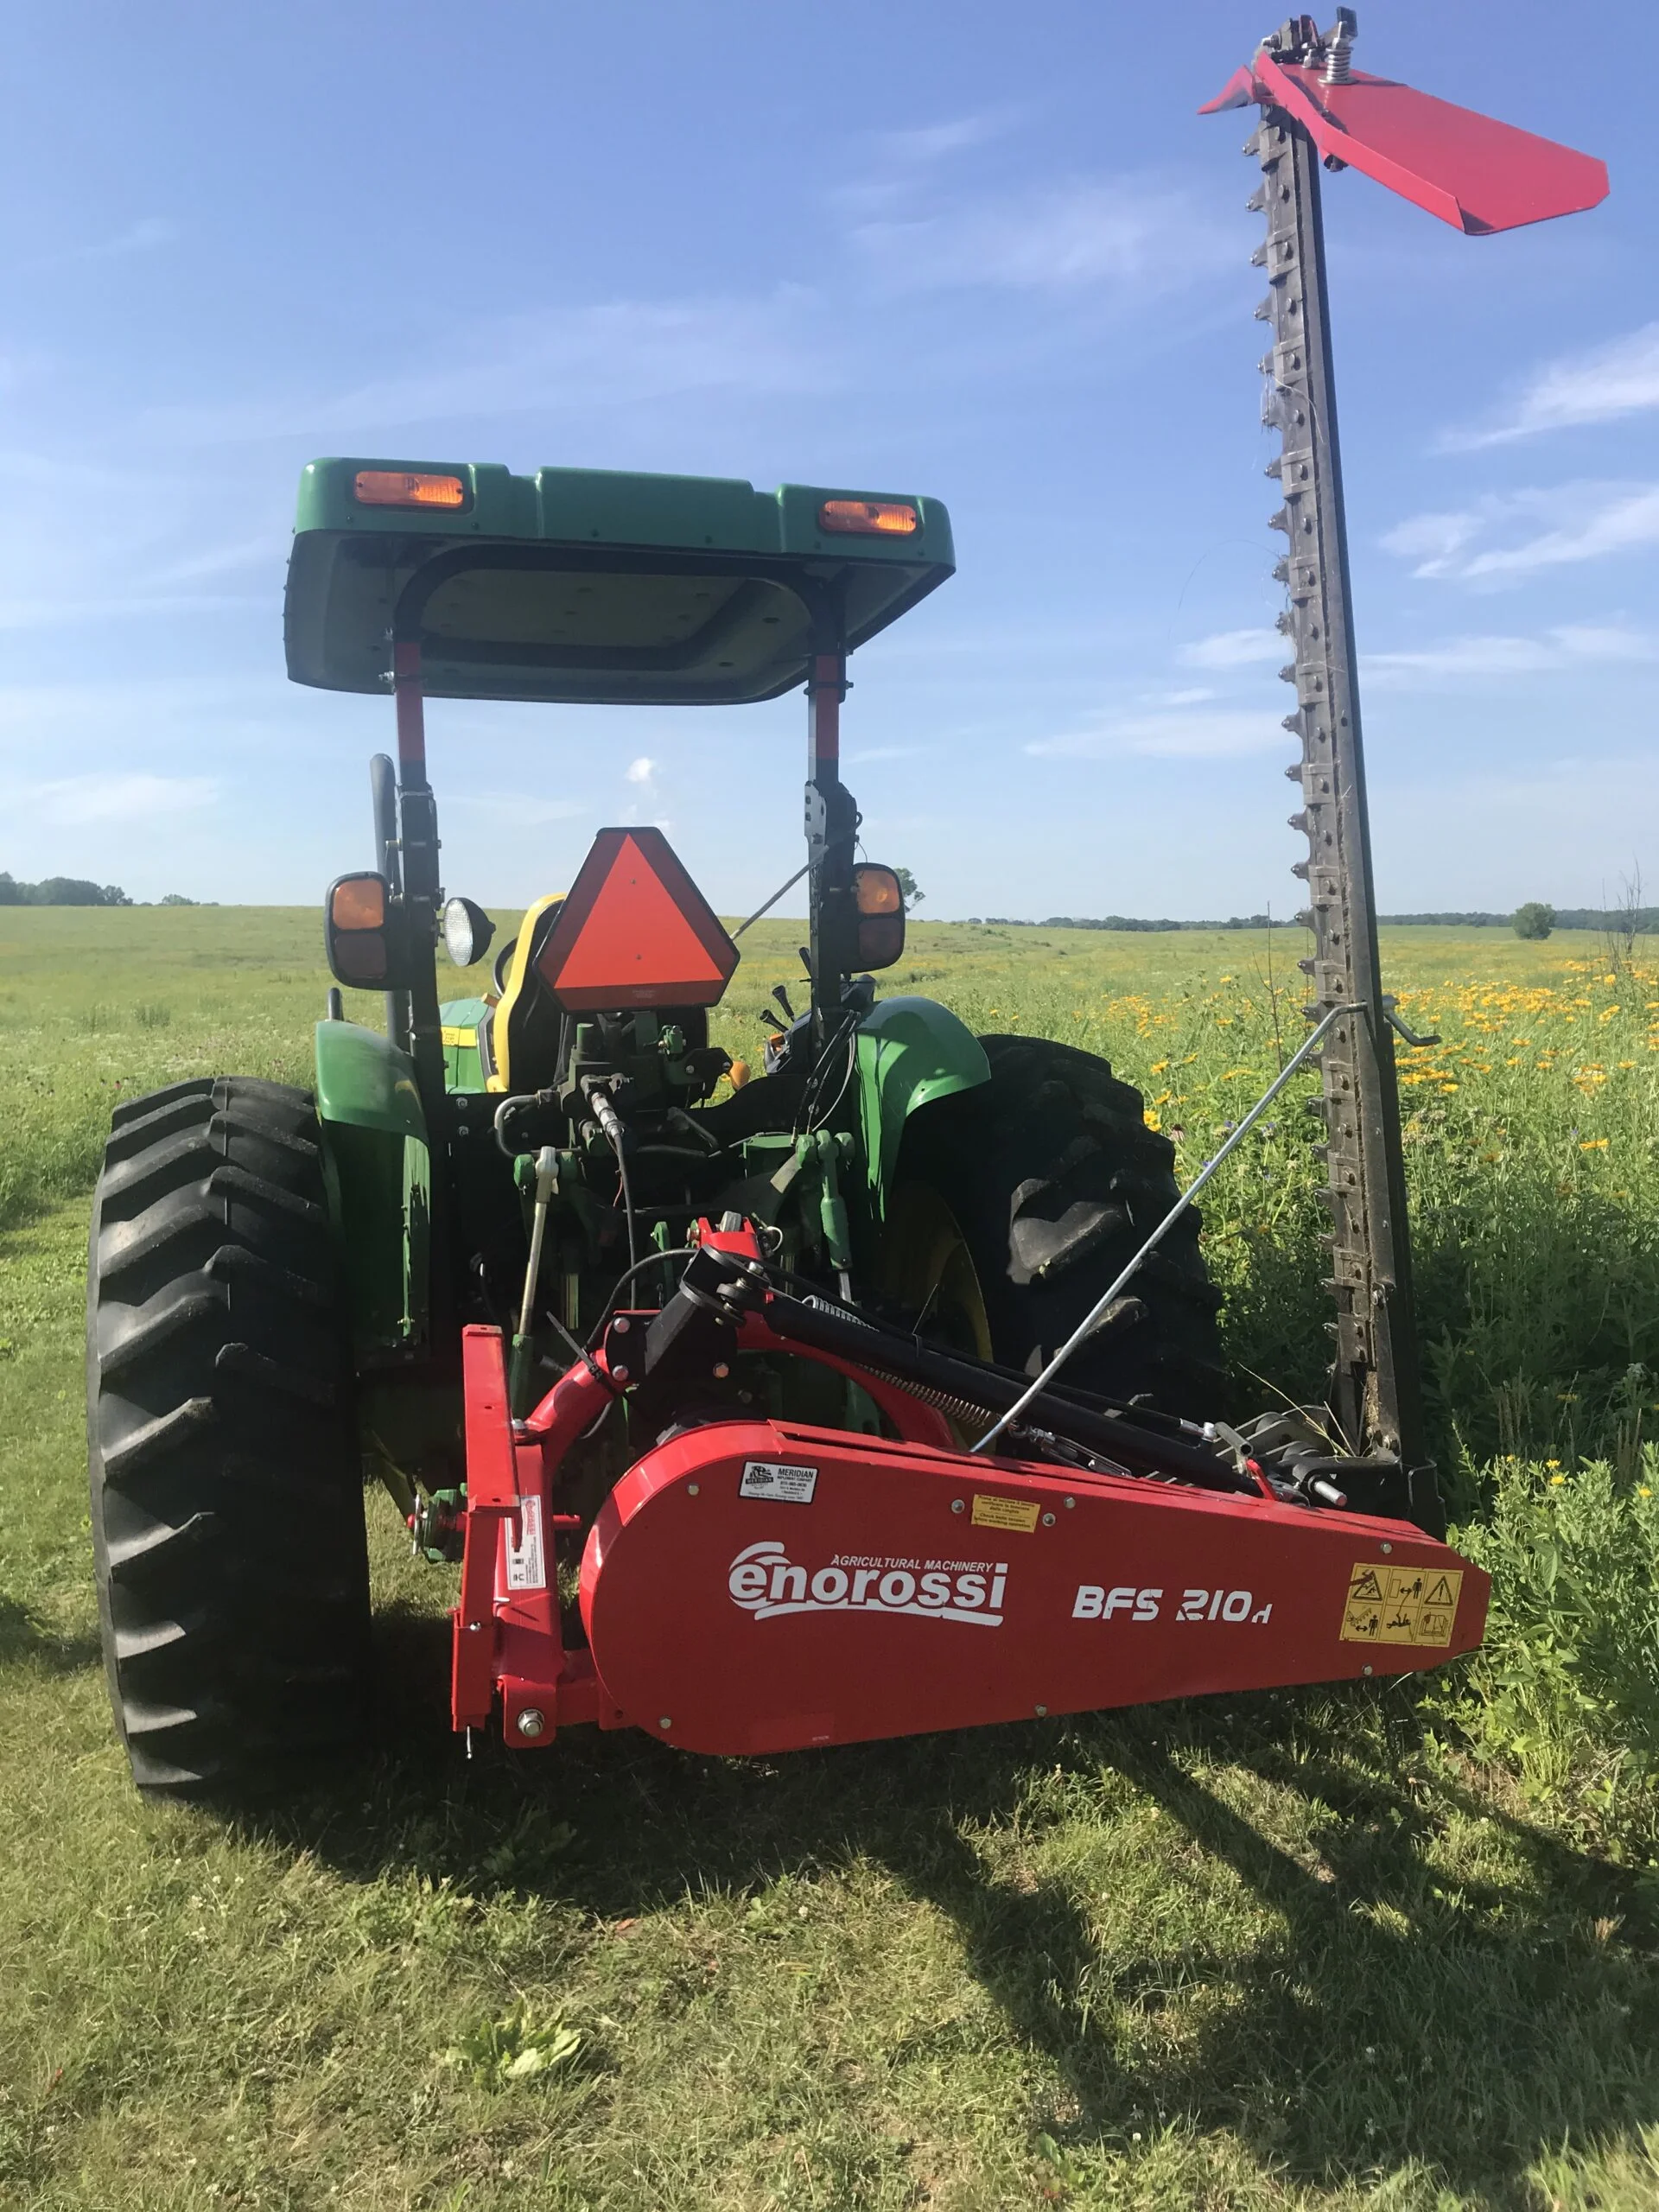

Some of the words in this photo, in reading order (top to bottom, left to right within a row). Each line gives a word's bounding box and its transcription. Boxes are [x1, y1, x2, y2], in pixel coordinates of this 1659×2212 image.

[778, 1467, 814, 1478] MERIDIAN
[830, 1554, 922, 1570] AGRICULTURAL
[924, 1560, 994, 1573] MACHINERY
[728, 1562, 1008, 1609] enorossi
[1071, 1585, 1164, 1621] BFS
